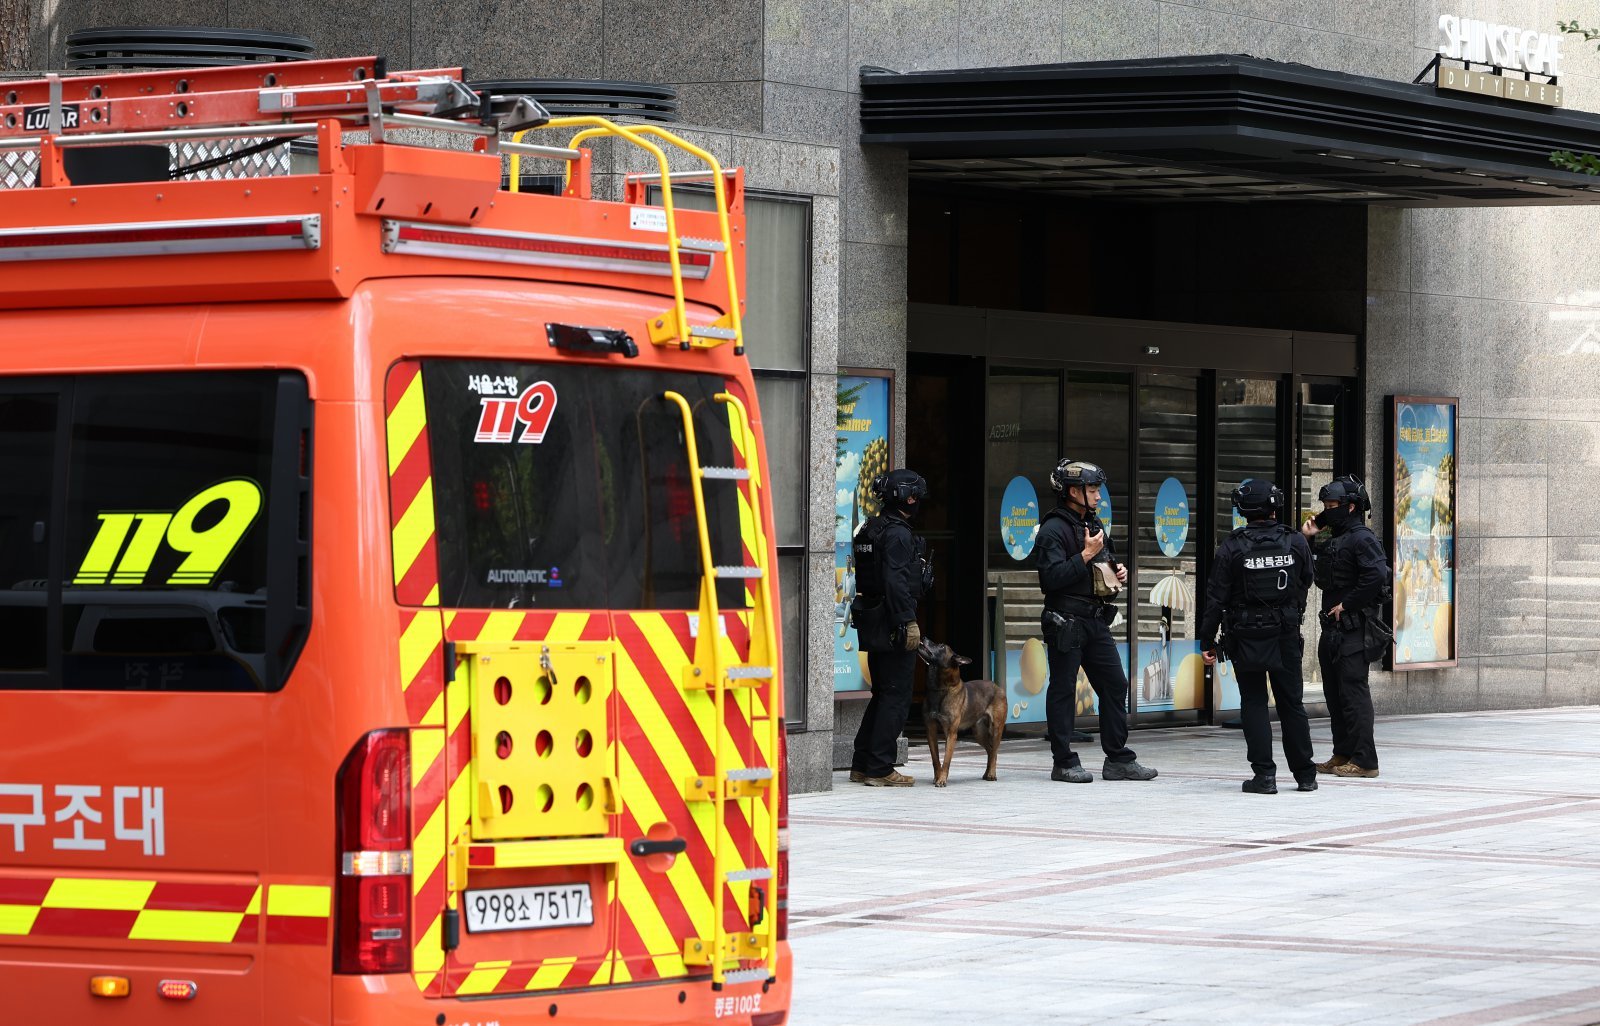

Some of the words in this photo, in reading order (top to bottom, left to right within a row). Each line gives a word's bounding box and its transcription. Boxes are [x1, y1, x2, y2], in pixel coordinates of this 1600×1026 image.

[1439, 14, 1563, 77] SHINSEGAE
[1448, 71, 1500, 93] DUTY
[1509, 82, 1559, 103] FREE
[468, 374, 518, 396] 서울소방
[474, 380, 558, 444] 119
[72, 480, 261, 585] 119
[487, 569, 547, 583] AUTOMATIC
[1244, 555, 1294, 569] 경찰특공대
[0, 783, 165, 856] 구조대
[714, 993, 762, 1018] 종로100호
